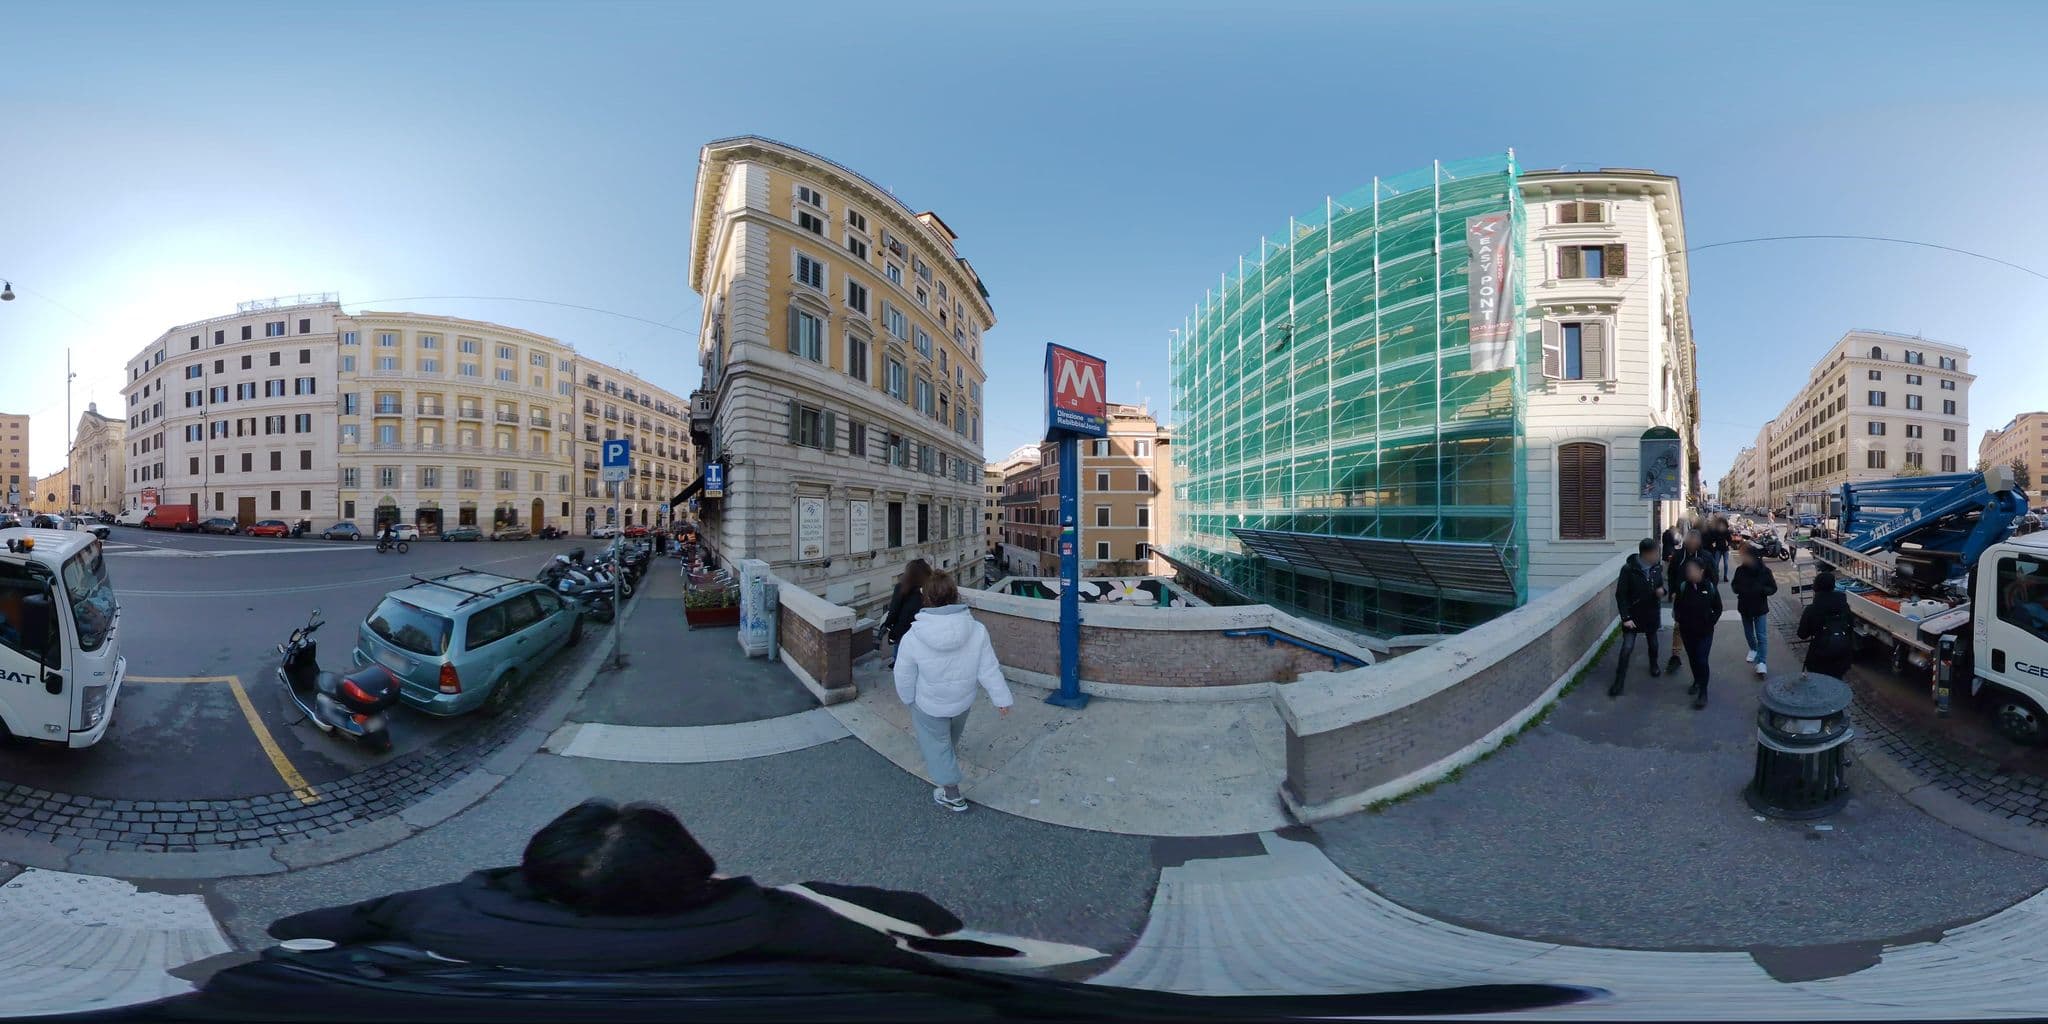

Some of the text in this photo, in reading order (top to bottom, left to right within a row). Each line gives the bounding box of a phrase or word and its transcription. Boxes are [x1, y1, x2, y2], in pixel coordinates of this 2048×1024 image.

[1479, 237, 1494, 320] EASY PONT
[1057, 359, 1102, 403] M
[1057, 409, 1084, 421] Direzione
[608, 444, 624, 463] P
[708, 465, 720, 482] T
